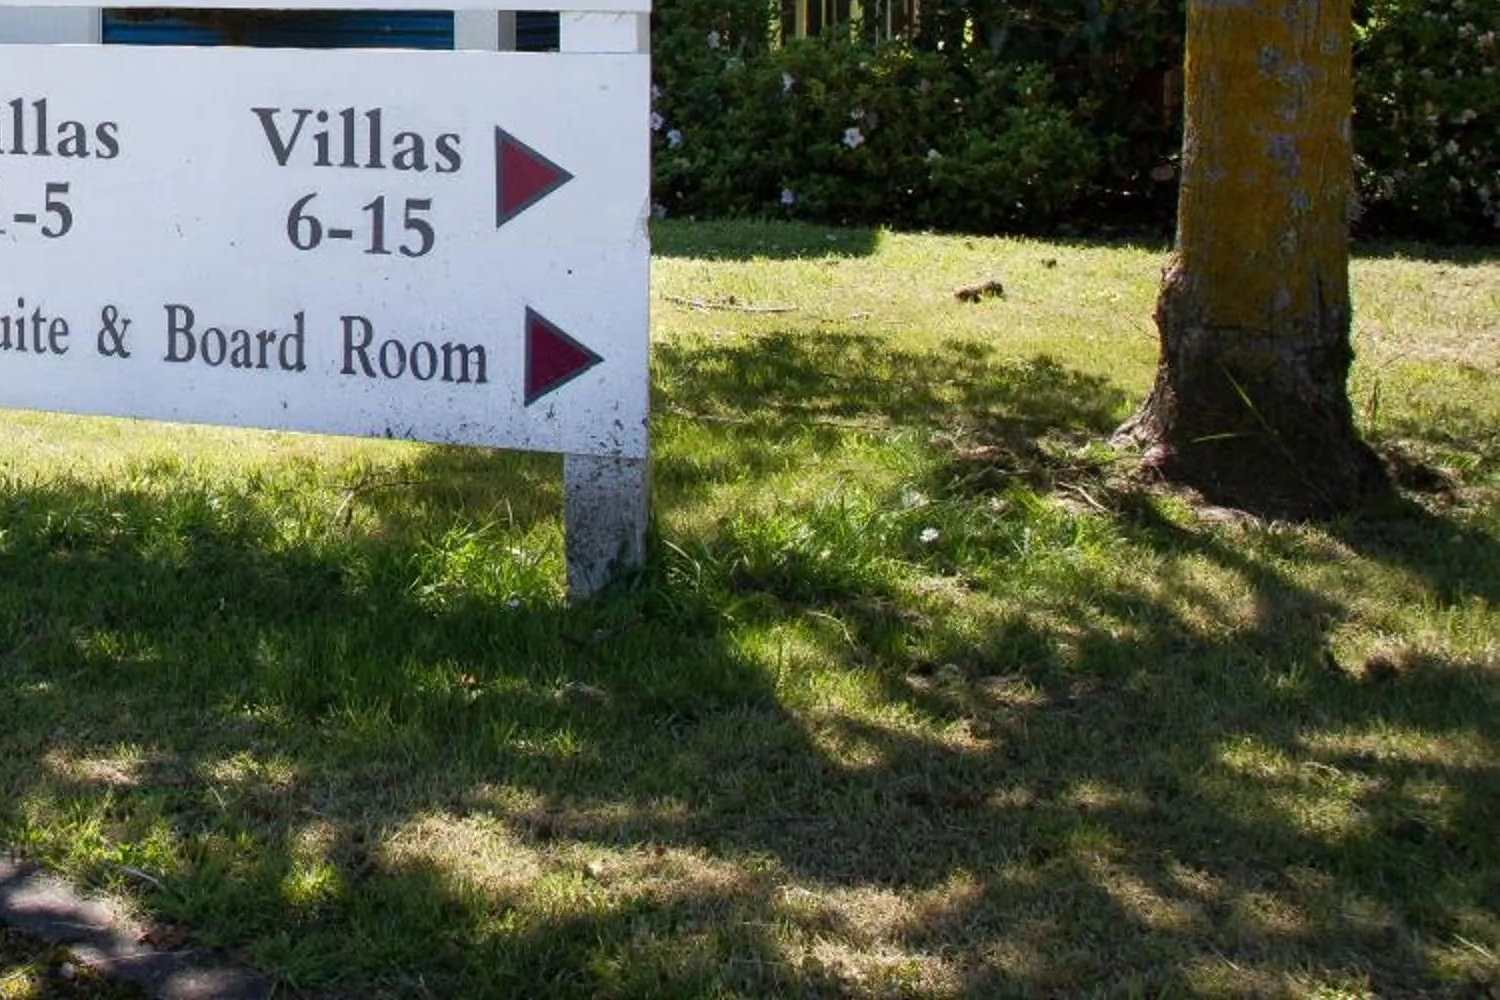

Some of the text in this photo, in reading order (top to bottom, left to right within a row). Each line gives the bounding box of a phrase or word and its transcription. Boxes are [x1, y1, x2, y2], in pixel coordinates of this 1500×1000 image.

[251, 107, 462, 173] Villas
[286, 192, 435, 258] 6-15
[97, 304, 132, 359] &
[163, 304, 307, 373] Board
[339, 315, 489, 385] Room
